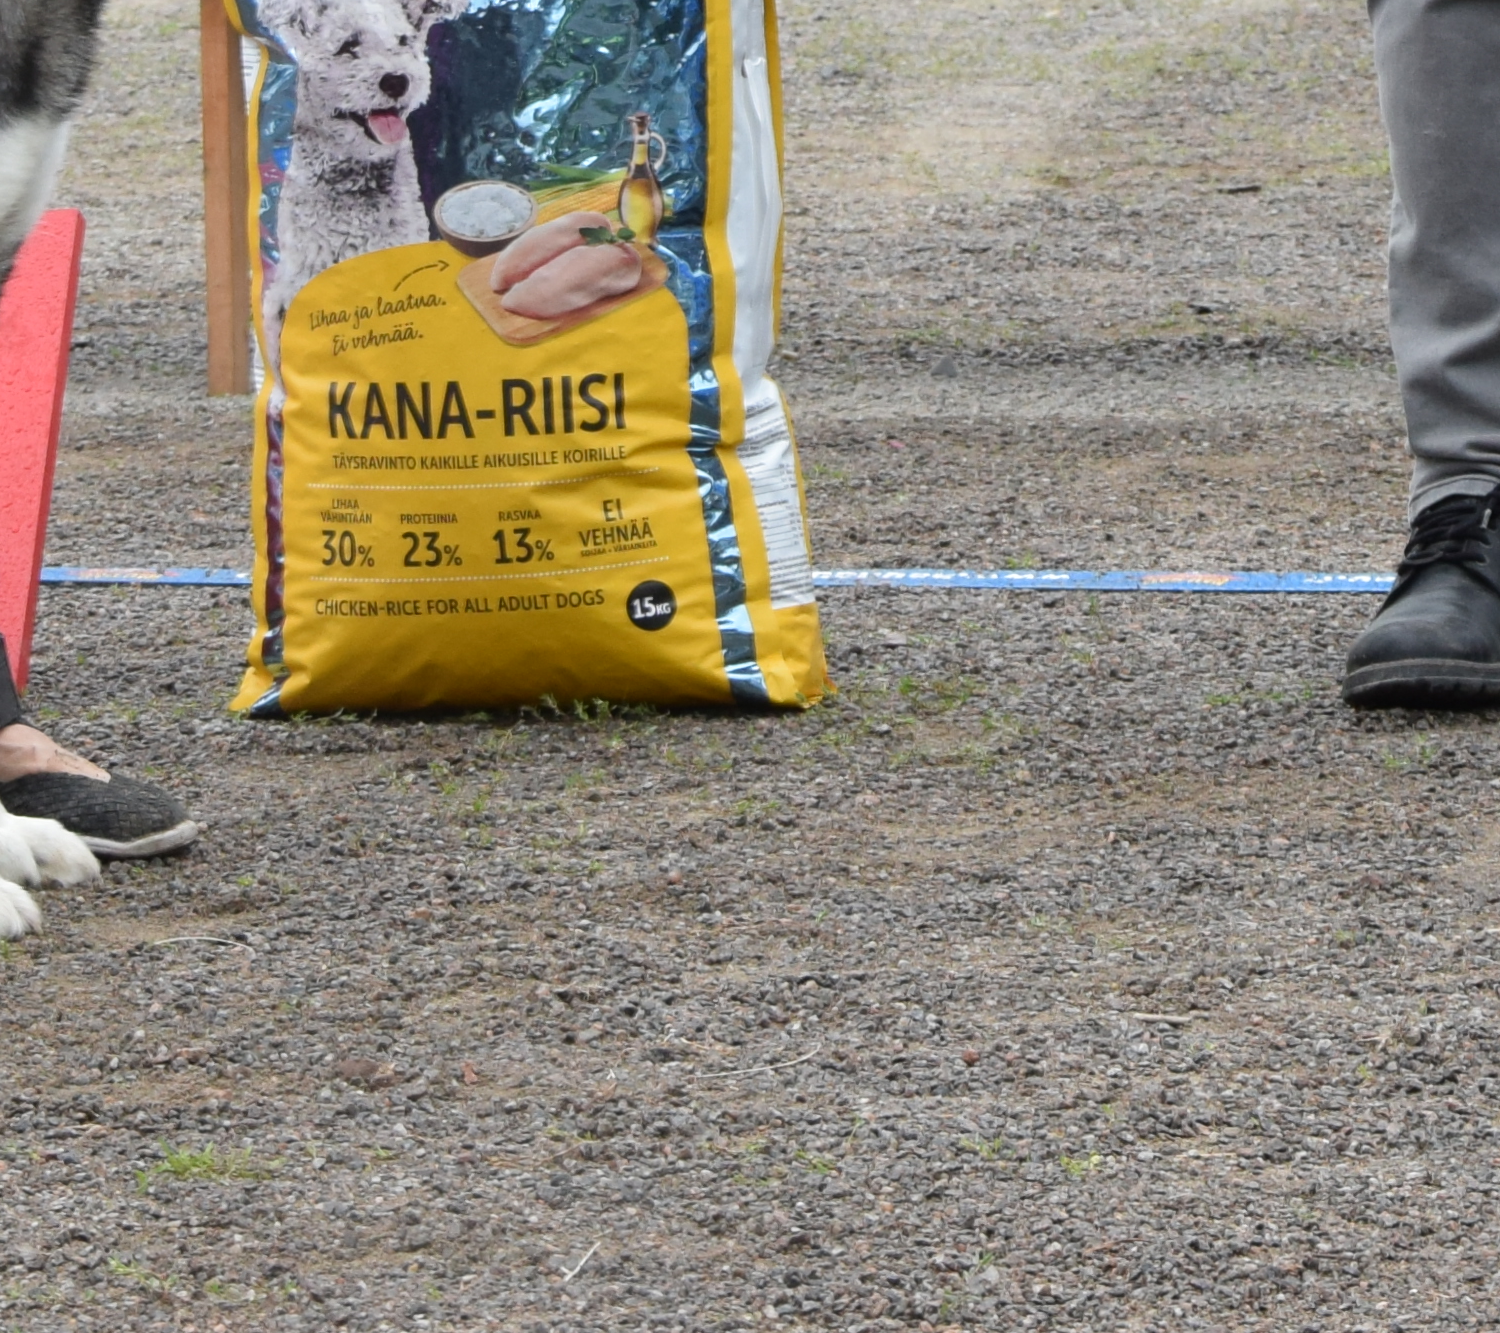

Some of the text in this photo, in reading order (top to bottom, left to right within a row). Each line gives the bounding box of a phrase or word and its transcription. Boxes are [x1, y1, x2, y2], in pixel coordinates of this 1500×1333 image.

[309, 294, 448, 331] Lihaa ja laatua.
[332, 321, 425, 357] Ei vehnää.
[327, 372, 628, 440] KANA-RIISI
[331, 444, 628, 471] TÄYSRAVINTO KAIKILLE AIKUISILLE KOIRILLE
[320, 510, 373, 524] VÄHINTÄÄN
[331, 498, 360, 510] LIHAA
[498, 509, 542, 523] RASVAA
[602, 498, 625, 523] EI
[400, 513, 459, 525] PROTEIINIA
[578, 516, 654, 548] VEHNÄÄ
[321, 529, 375, 568] 30%
[401, 531, 463, 568] 23%
[492, 526, 555, 565] 13%
[315, 589, 606, 617] CHICKEN-RICE FOR ALL ADULT DOGS
[631, 596, 672, 620] 15KG
